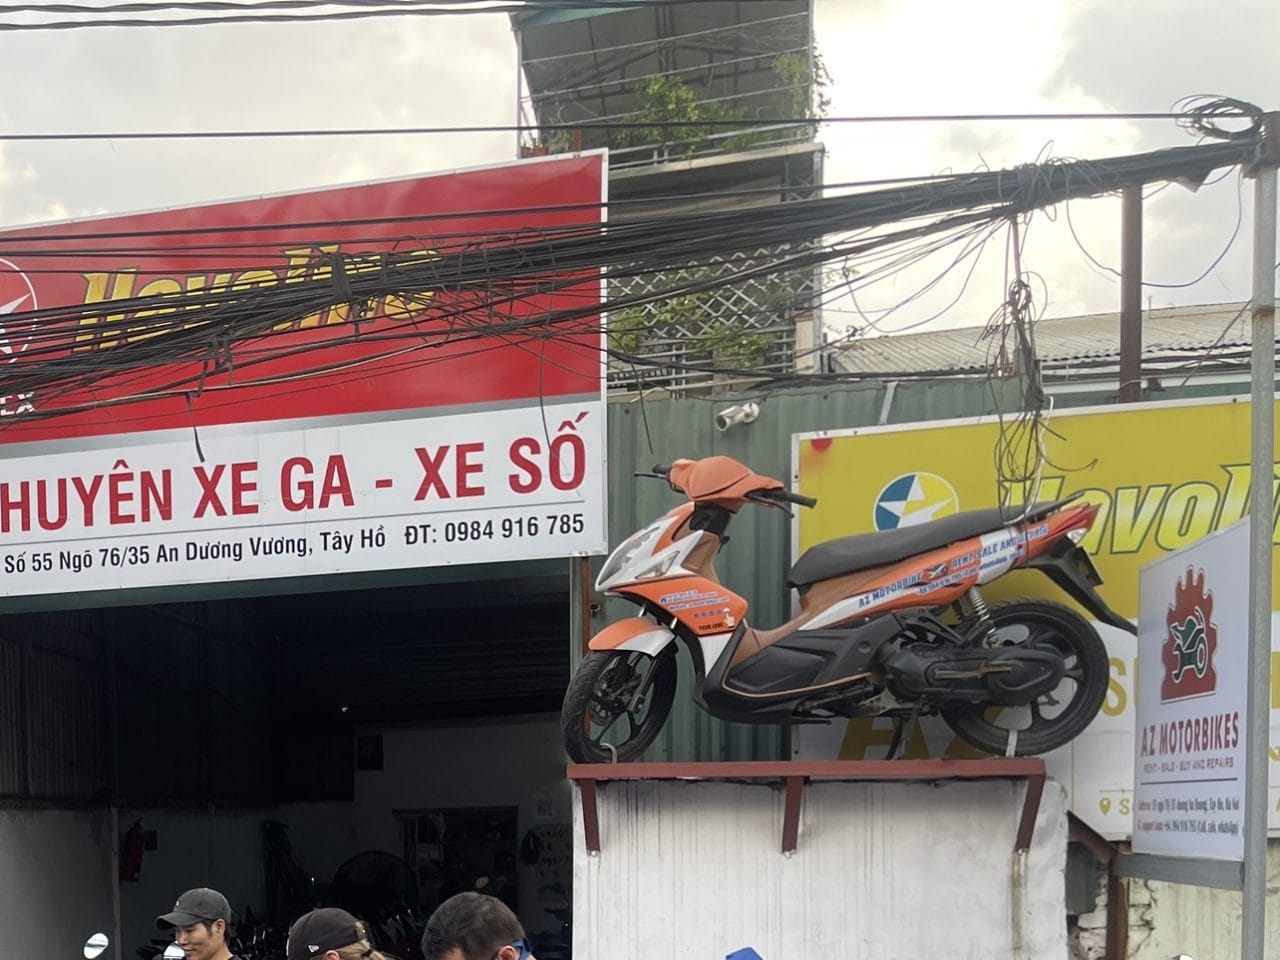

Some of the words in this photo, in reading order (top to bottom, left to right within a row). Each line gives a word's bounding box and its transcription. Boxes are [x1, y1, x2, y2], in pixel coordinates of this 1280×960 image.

[192, 460, 261, 520] XE
[279, 453, 355, 513] GA
[413, 441, 486, 502] XE
[508, 410, 590, 494] SỐ
[3, 550, 27, 574] Số
[31, 551, 54, 572] 55
[58, 547, 93, 573] Ngõ
[98, 545, 151, 569] 76/35
[155, 542, 180, 564] An
[185, 536, 244, 563] Dương
[249, 532, 315, 560] Vương,
[319, 529, 354, 555] Tây
[360, 524, 387, 550] Hồ
[404, 523, 438, 546] ĐT:
[444, 519, 495, 543] 0984
[501, 515, 539, 539] 916
[546, 512, 585, 536] 785
[1140, 724, 1156, 758] AZ
[1159, 711, 1239, 756] MOTORBIKES
